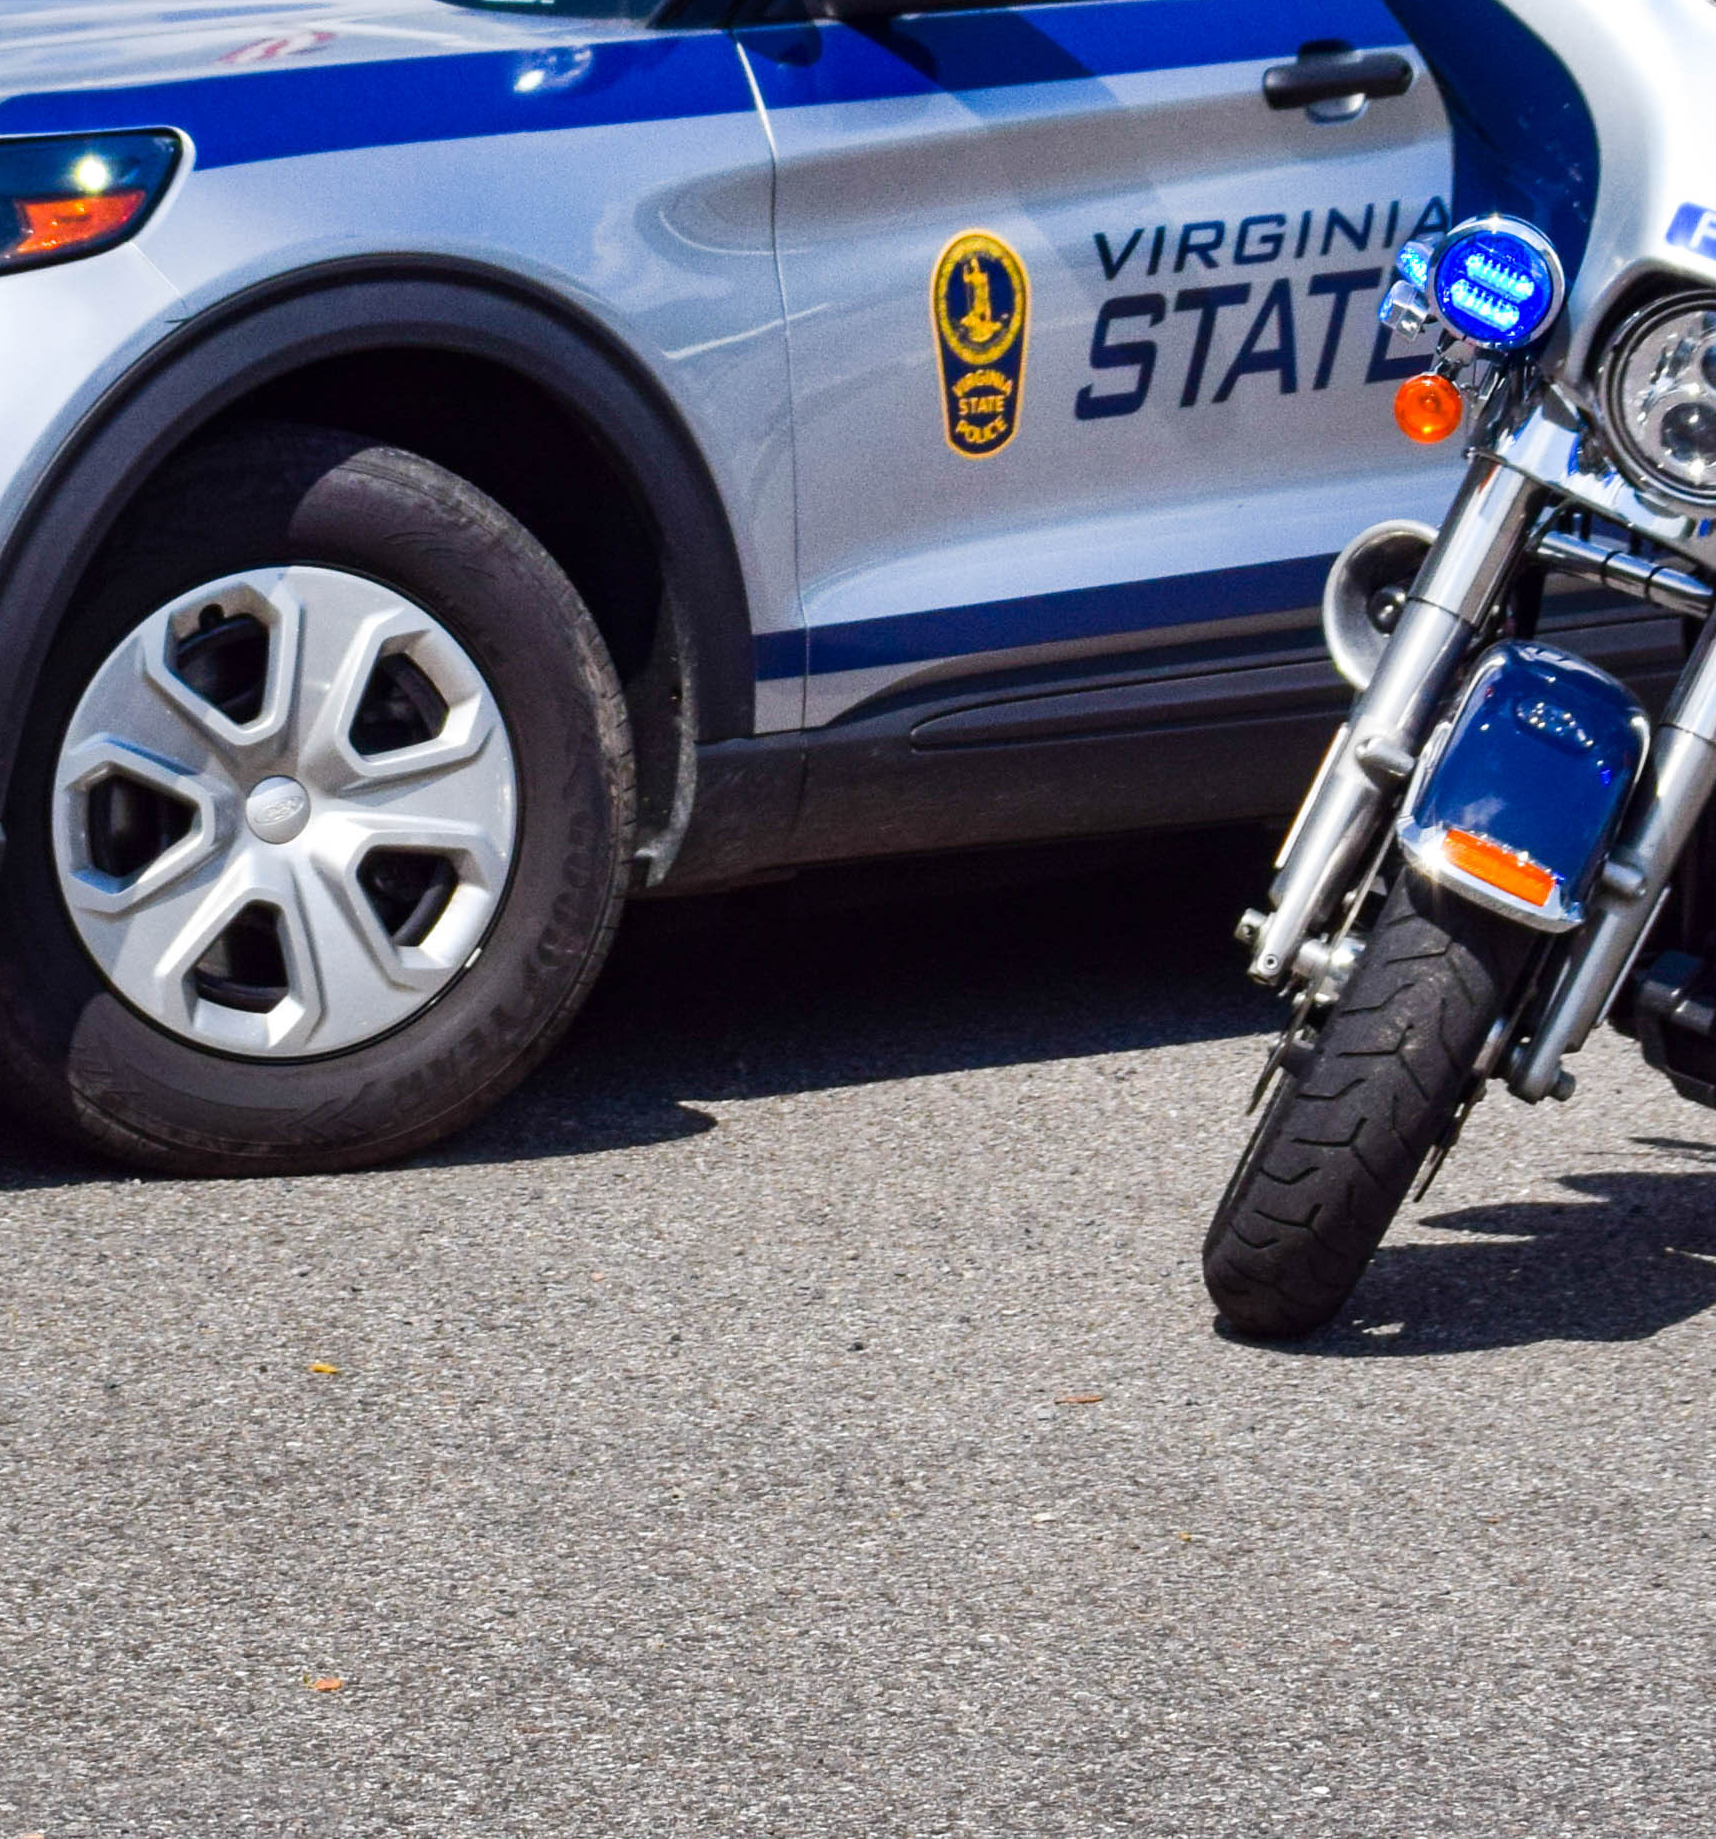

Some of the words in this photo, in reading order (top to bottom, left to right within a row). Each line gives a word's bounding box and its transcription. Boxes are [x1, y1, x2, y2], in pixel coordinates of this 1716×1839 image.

[1095, 196, 1450, 280] VIRGINIA
[958, 394, 1005, 416] STATE
[955, 414, 1008, 443] POLICE
